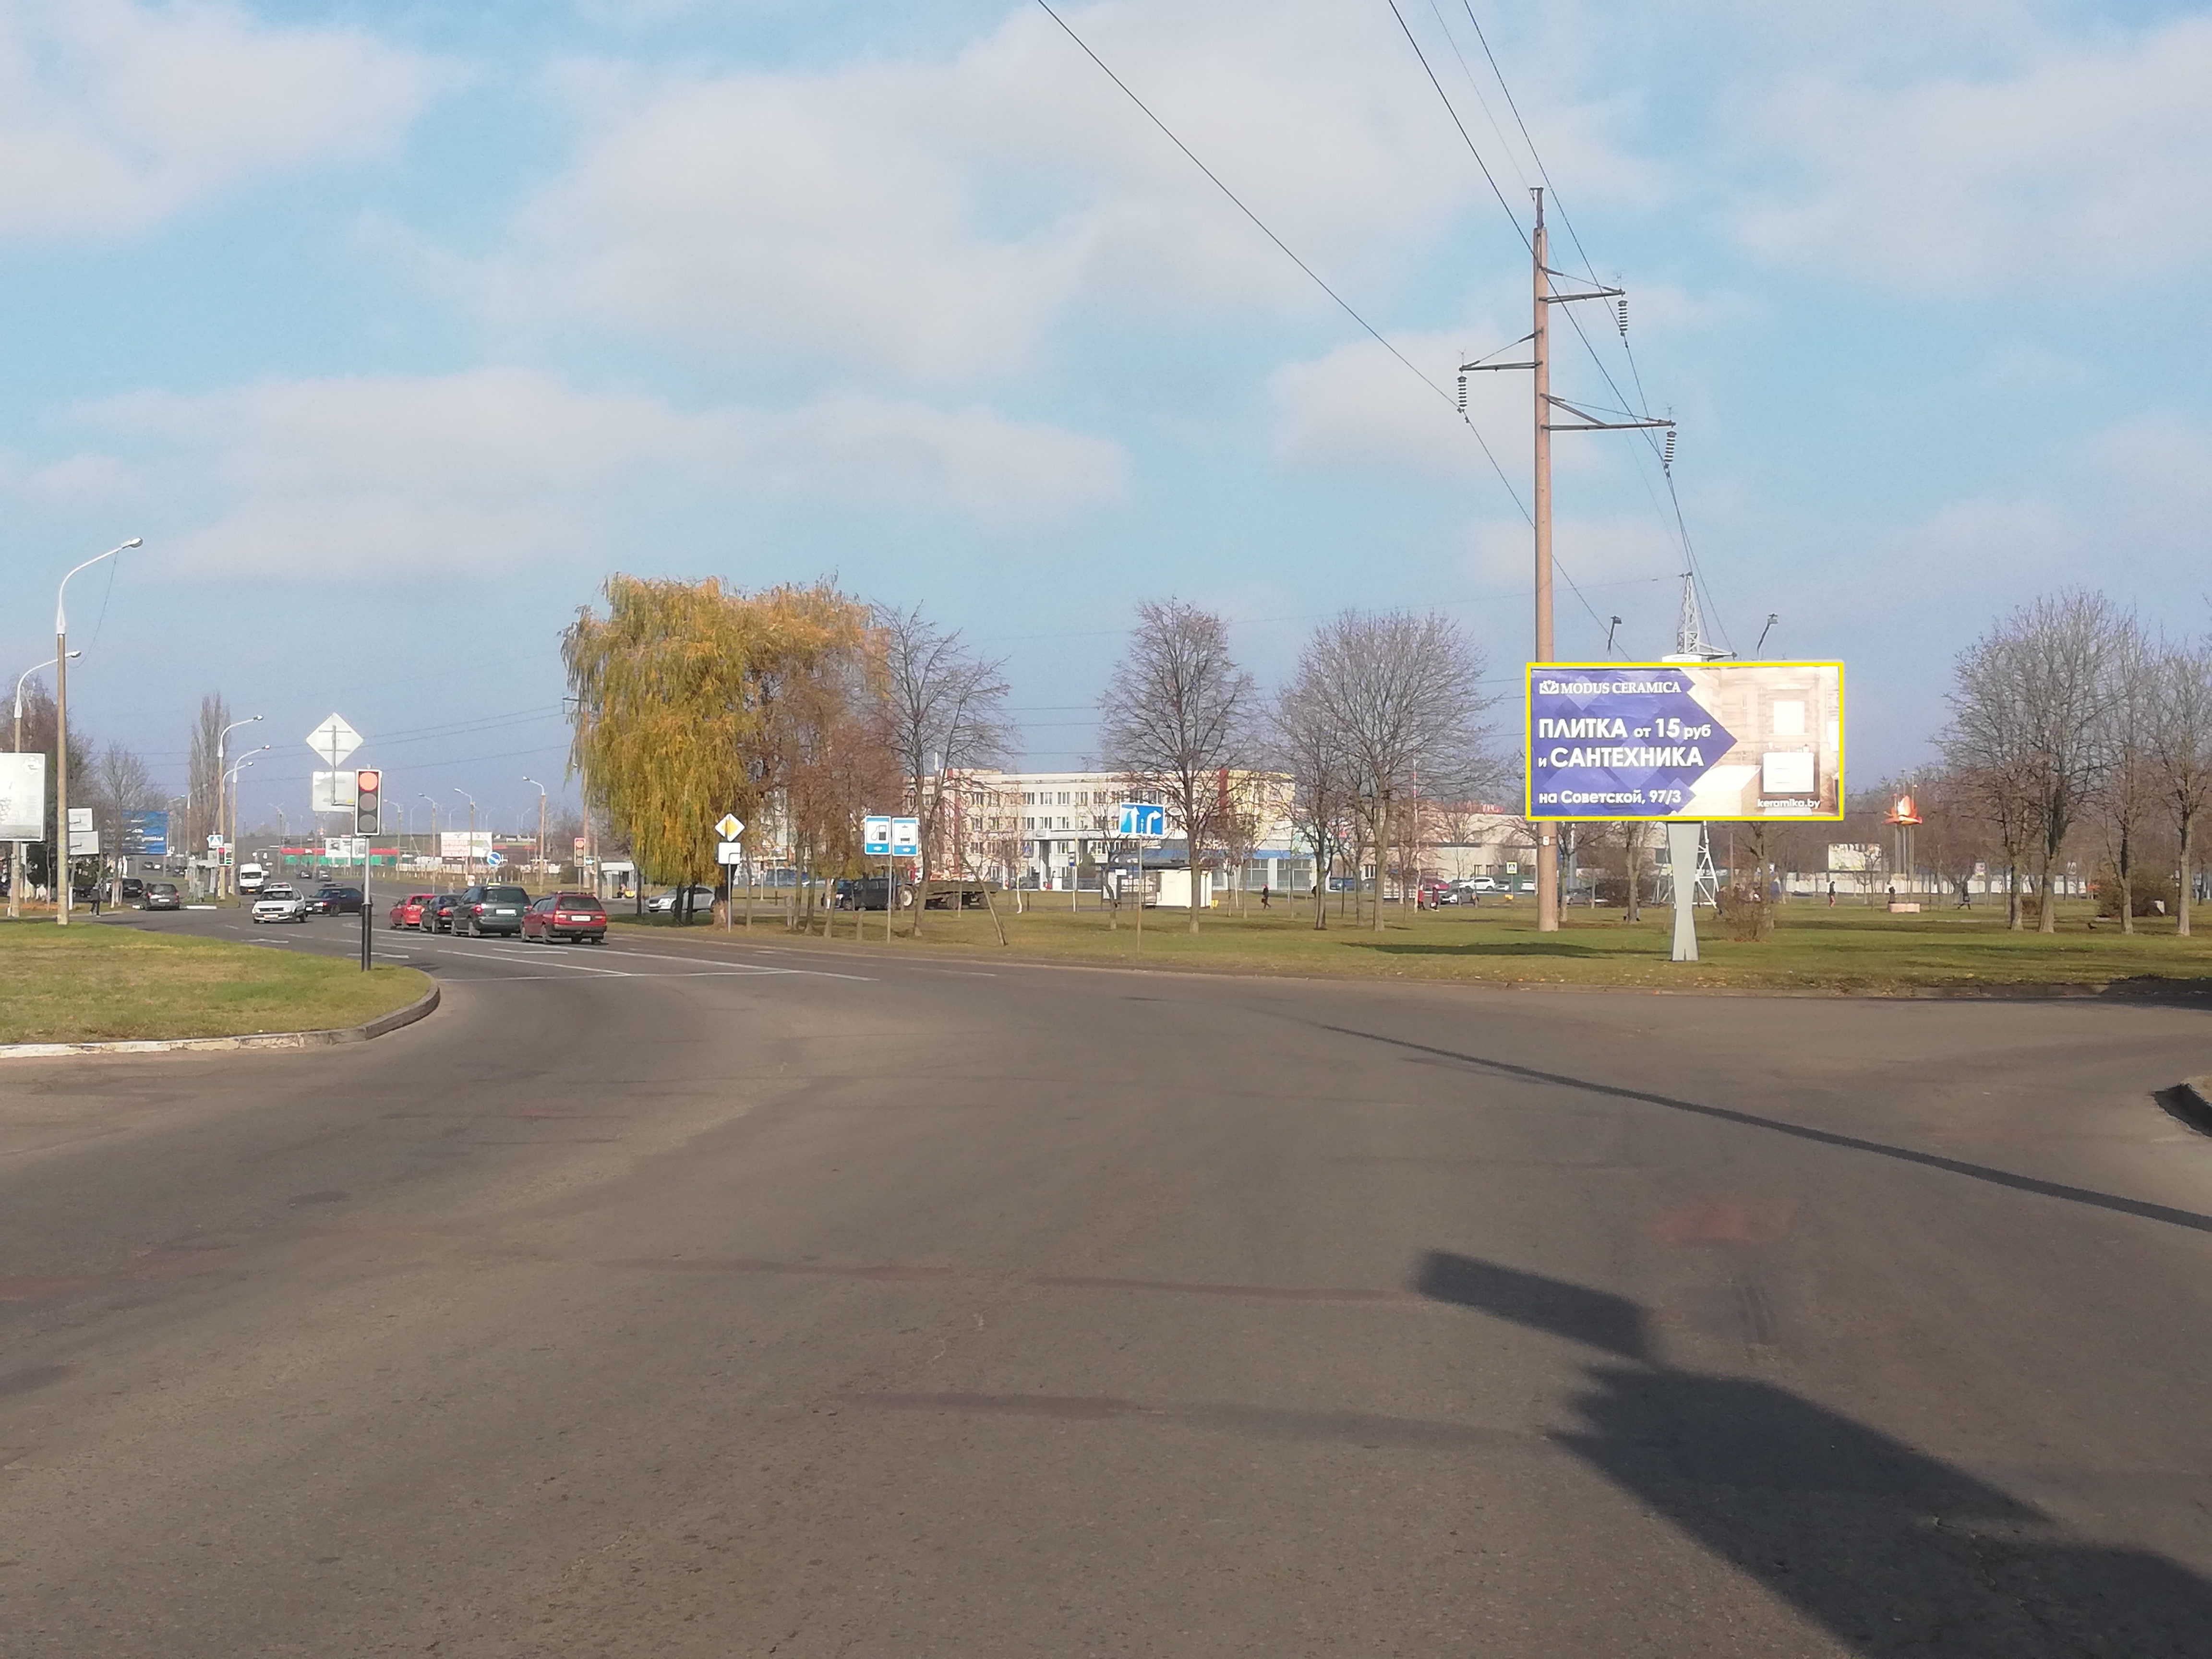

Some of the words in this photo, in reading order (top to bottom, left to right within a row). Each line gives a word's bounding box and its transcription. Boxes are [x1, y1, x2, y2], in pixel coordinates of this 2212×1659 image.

[1561, 682, 1610, 694] MODUS
[1612, 681, 1682, 693] CERAMICA
[1539, 718, 1628, 738] ПЛИТКА
[1634, 727, 1651, 738] от
[1655, 718, 1680, 737] 15
[1684, 724, 1711, 740] руб
[1538, 757, 1547, 767] и
[1551, 747, 1704, 767] САНТЕХНИКА
[1539, 793, 1557, 804] на
[1561, 790, 1646, 805] Советской,
[1649, 790, 1681, 805] 97/3
[1757, 798, 1820, 809] keramika.by
